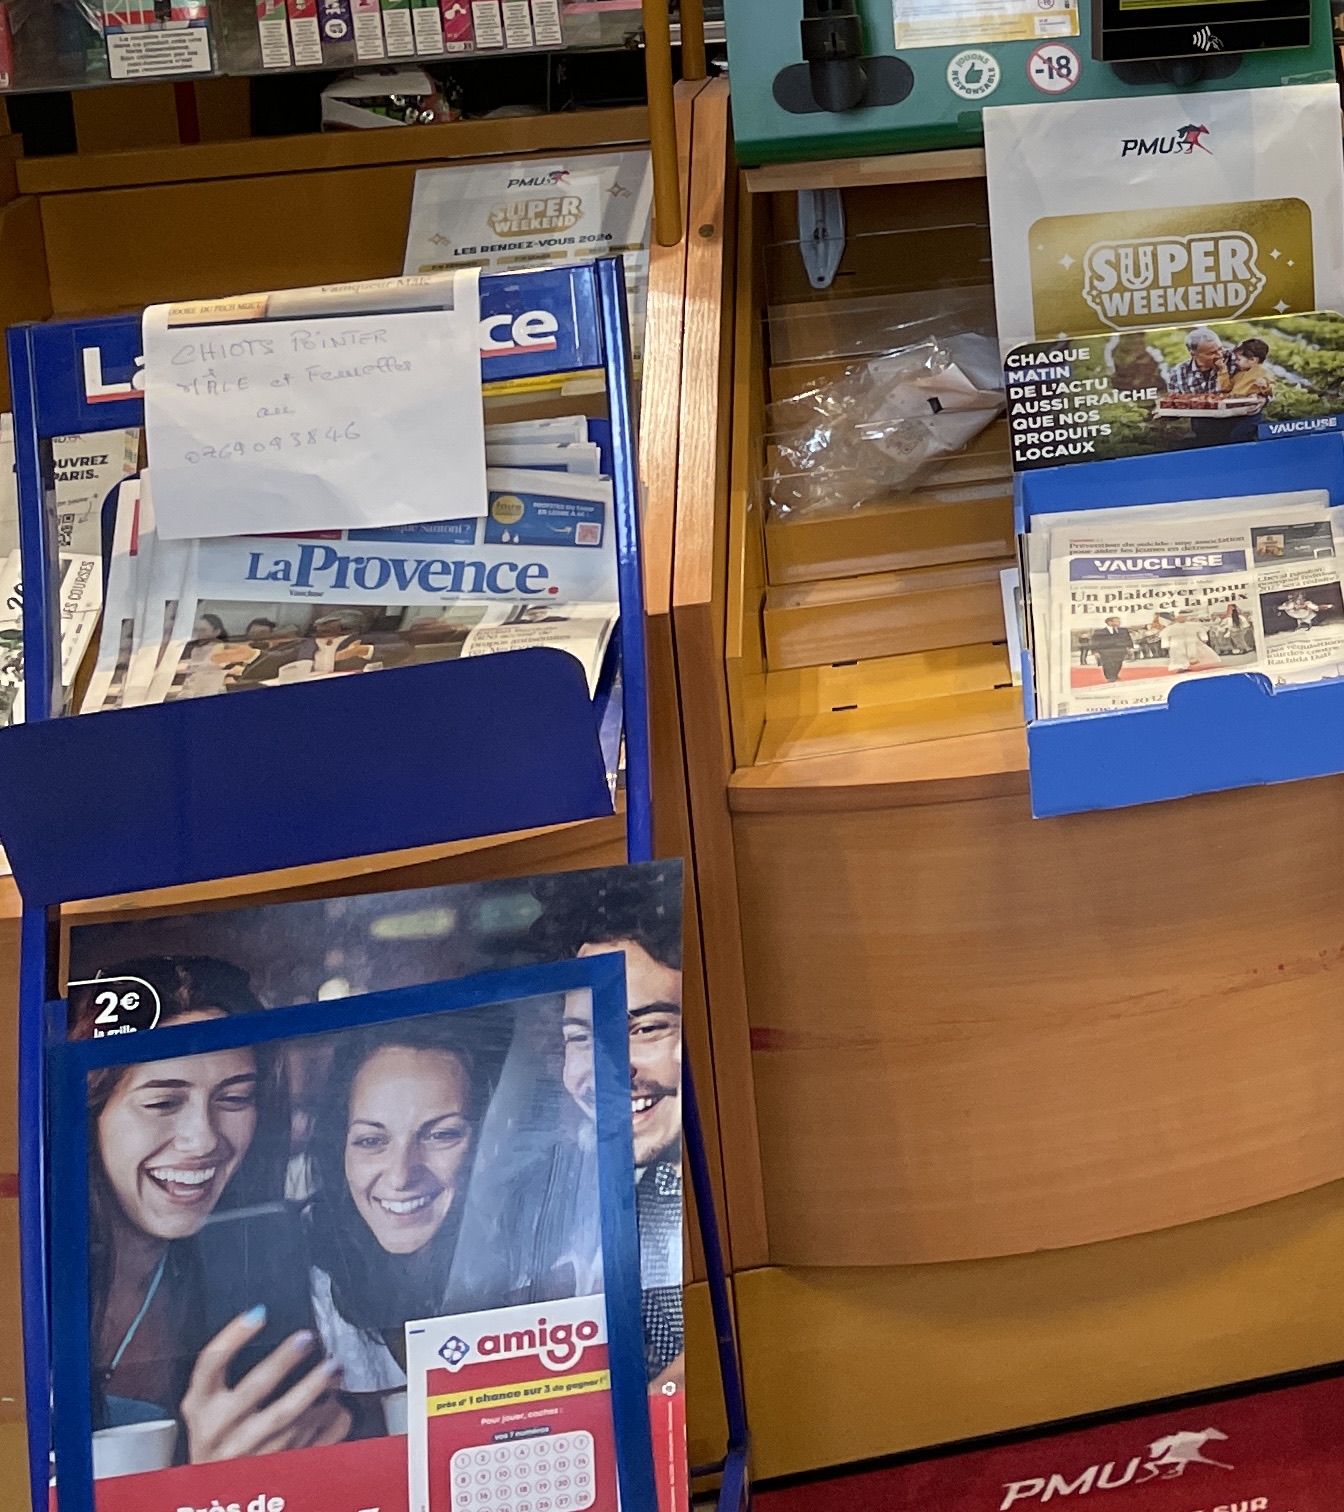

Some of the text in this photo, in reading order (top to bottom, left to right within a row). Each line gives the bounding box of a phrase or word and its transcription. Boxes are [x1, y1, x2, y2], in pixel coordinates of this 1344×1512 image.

[1035, 55, 1072, 80] -18
[492, 197, 580, 221] SUPER
[494, 216, 577, 234] WEEKEND
[453, 233, 613, 256] LES RENDEZ-VOUS 2026
[1091, 238, 1253, 293] SUPER
[1101, 283, 1248, 318] WEEKEND
[1007, 347, 1090, 368] CHAQUE
[1008, 365, 1071, 384] MATIN
[1010, 377, 1109, 400] DE L'ACTU
[1011, 386, 1159, 416] AUSSI FRAÎCHE
[1012, 410, 1101, 431] QUE NOS
[1269, 417, 1337, 434] VAUCLUSE
[1014, 423, 1112, 447] PRODUITS
[1015, 440, 1095, 462] LOCAUX
[245, 550, 292, 584] La
[1094, 553, 1223, 572] VAUCLUSE
[1070, 583, 1250, 604] Un plaidoyer pour
[1070, 591, 1248, 616] l'Europe et la paix
[93, 990, 141, 1025] 2€
[476, 1317, 599, 1365] amigo
